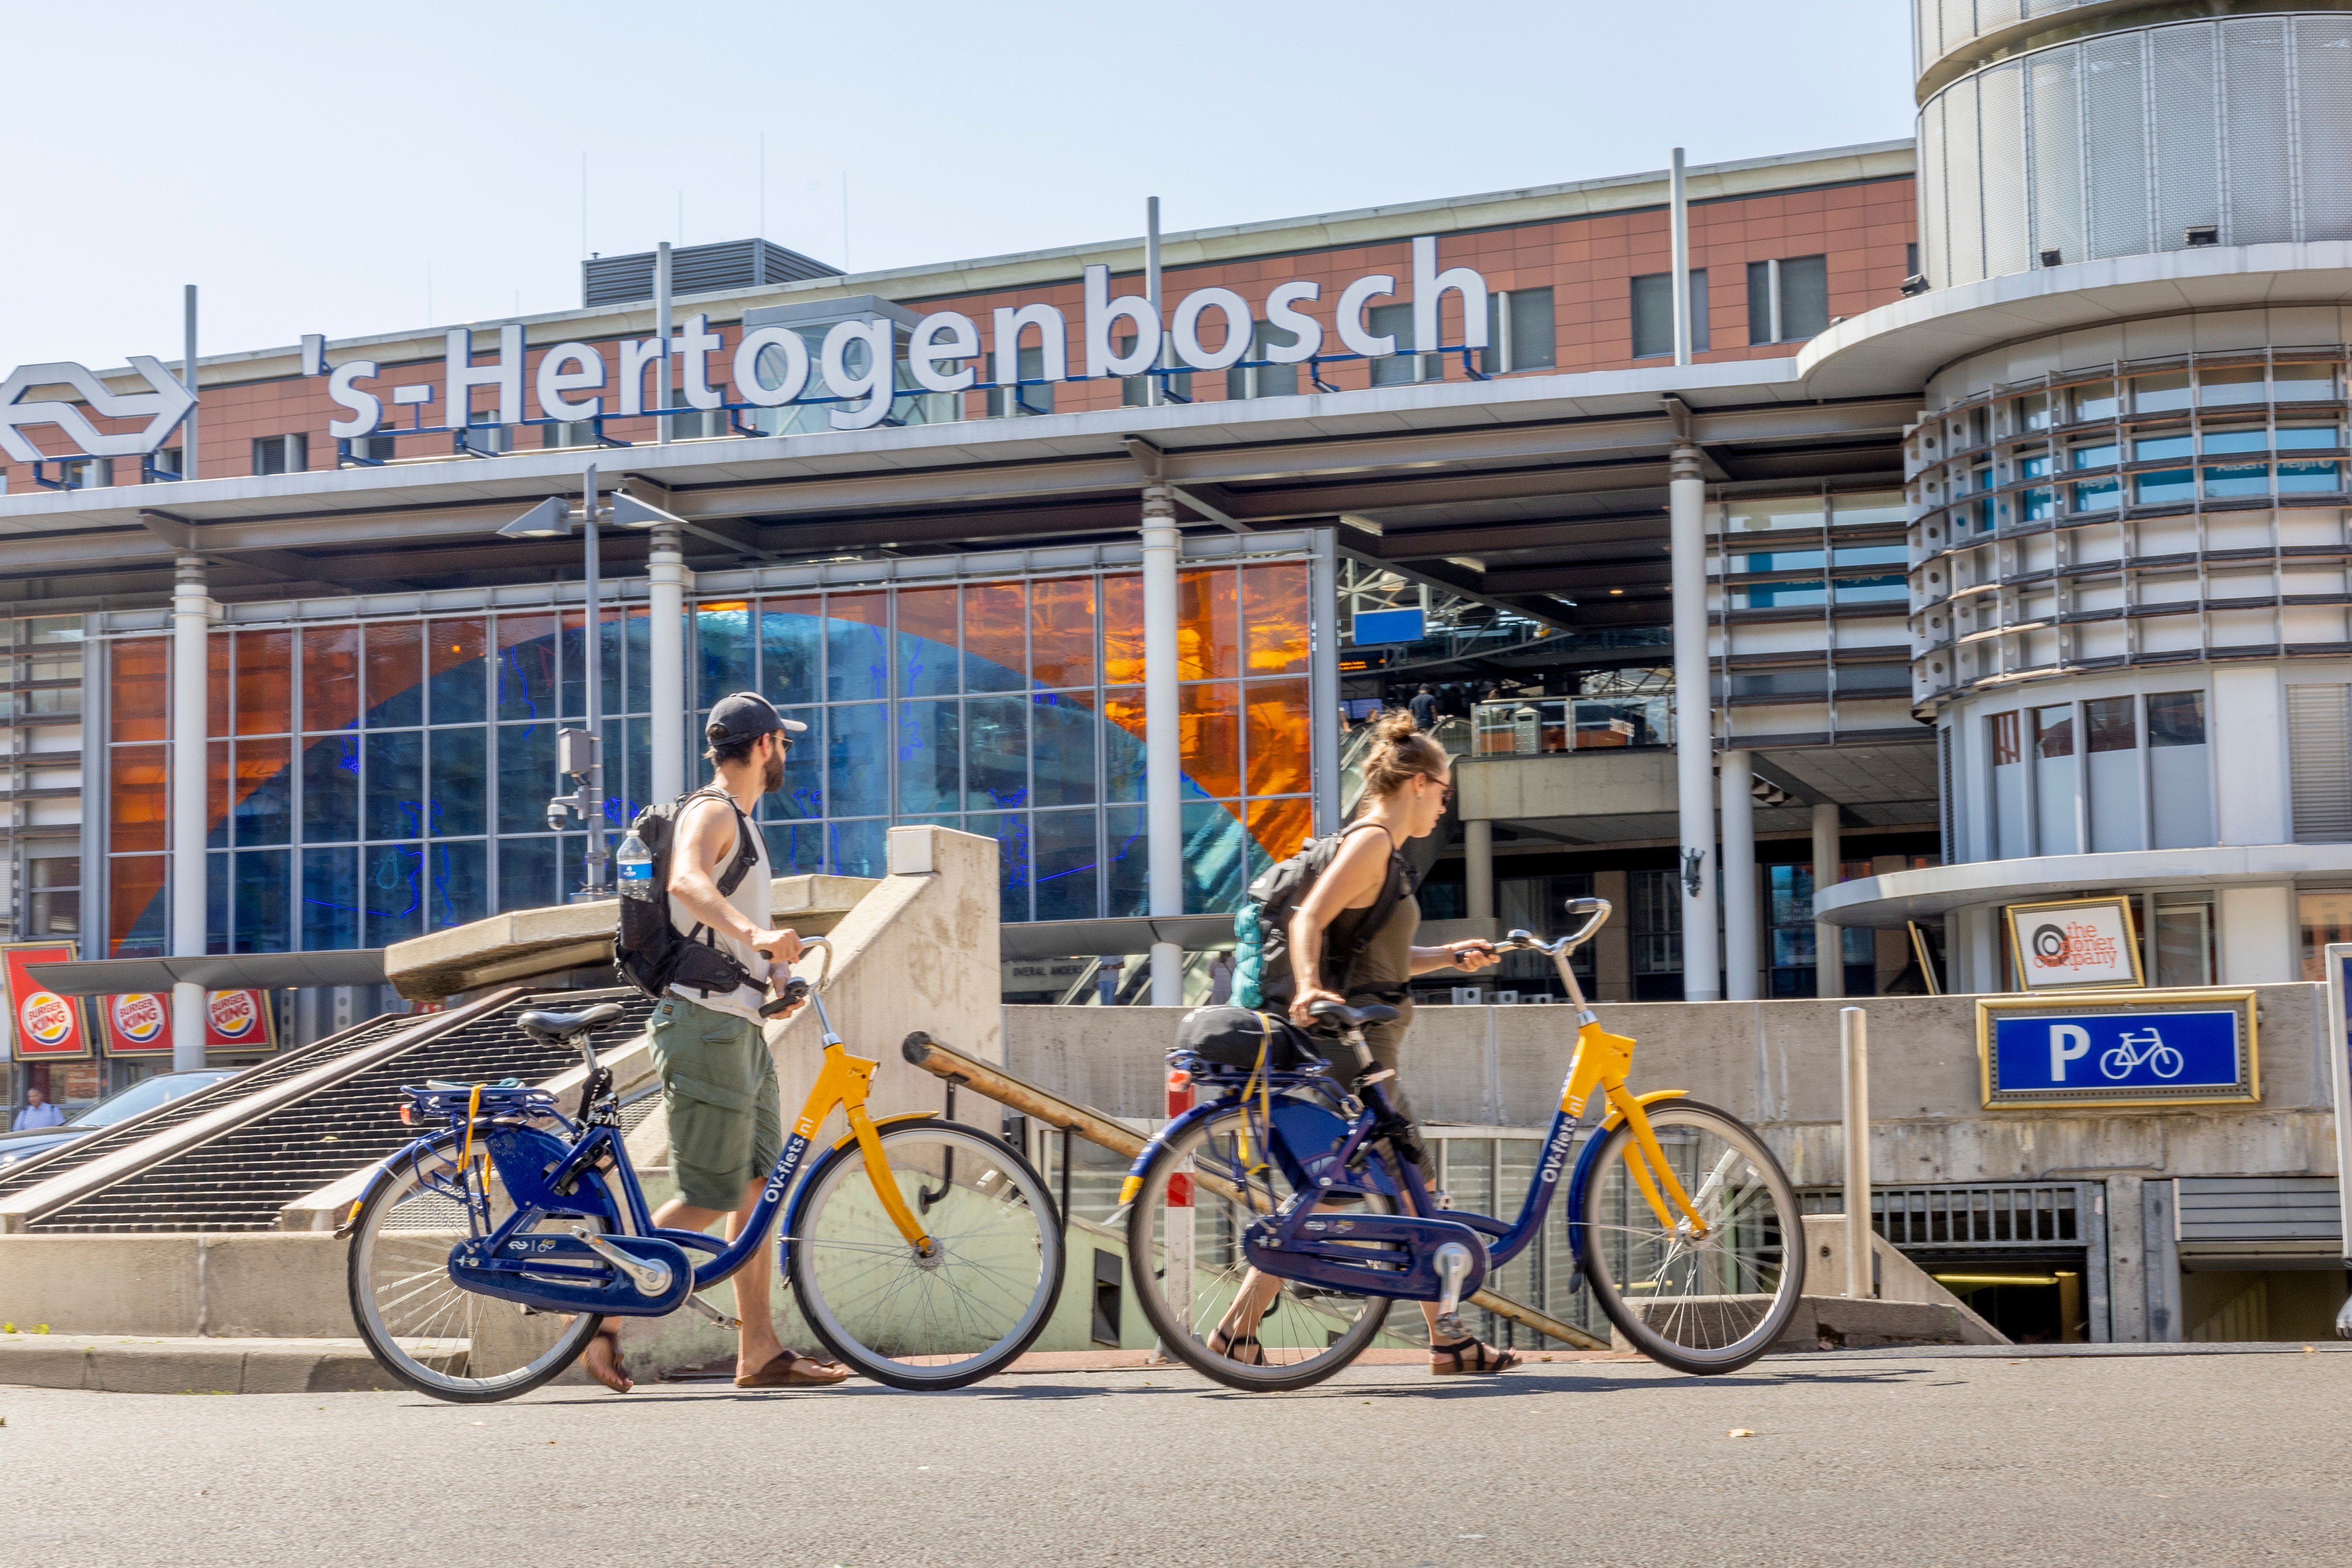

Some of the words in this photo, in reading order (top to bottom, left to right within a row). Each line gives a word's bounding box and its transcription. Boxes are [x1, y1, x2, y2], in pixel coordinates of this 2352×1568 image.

[301, 236, 1489, 438] 's-Hertogenbosch
[2066, 921, 2098, 939] the
[2033, 950, 2118, 971] company
[28, 1001, 62, 1020] BURGER
[119, 998, 154, 1018] BURGER
[211, 993, 246, 1013] BURGER
[215, 1002, 250, 1027] KING
[32, 1010, 66, 1035] KING
[123, 1007, 158, 1031] KING
[2049, 1024, 2091, 1082] P
[1540, 1094, 1585, 1183] OV-fiets.nl
[764, 1116, 815, 1202] OV-fiets.nl
